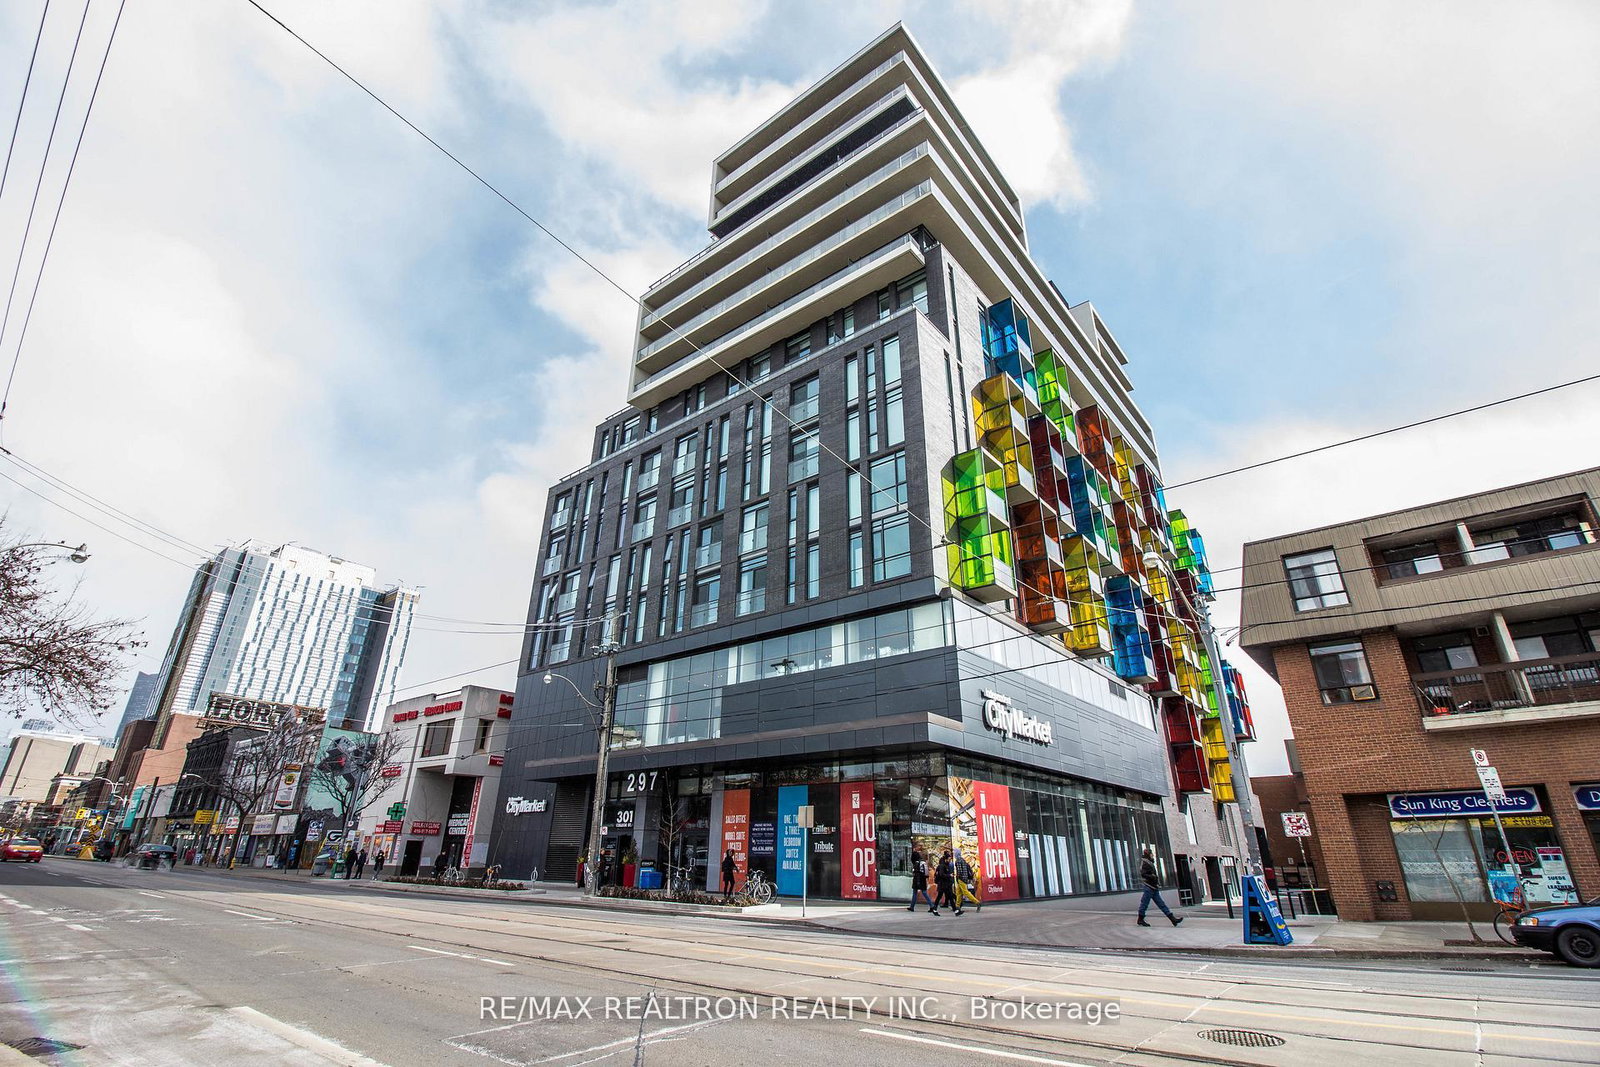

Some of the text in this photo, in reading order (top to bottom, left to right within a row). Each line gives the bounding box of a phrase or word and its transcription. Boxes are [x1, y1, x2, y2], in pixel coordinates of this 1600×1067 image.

[984, 699, 1053, 744] CityMarket
[626, 772, 658, 792] 297
[506, 799, 547, 817] CityMarket
[1400, 796, 1527, 811] Sun King Cleaners
[616, 810, 634, 823] 301
[981, 813, 1007, 844] NOW
[814, 840, 834, 850] Tribute
[852, 847, 876, 878] OP
[984, 848, 1012, 879] OPEN
[1496, 849, 1535, 863] OPEN
